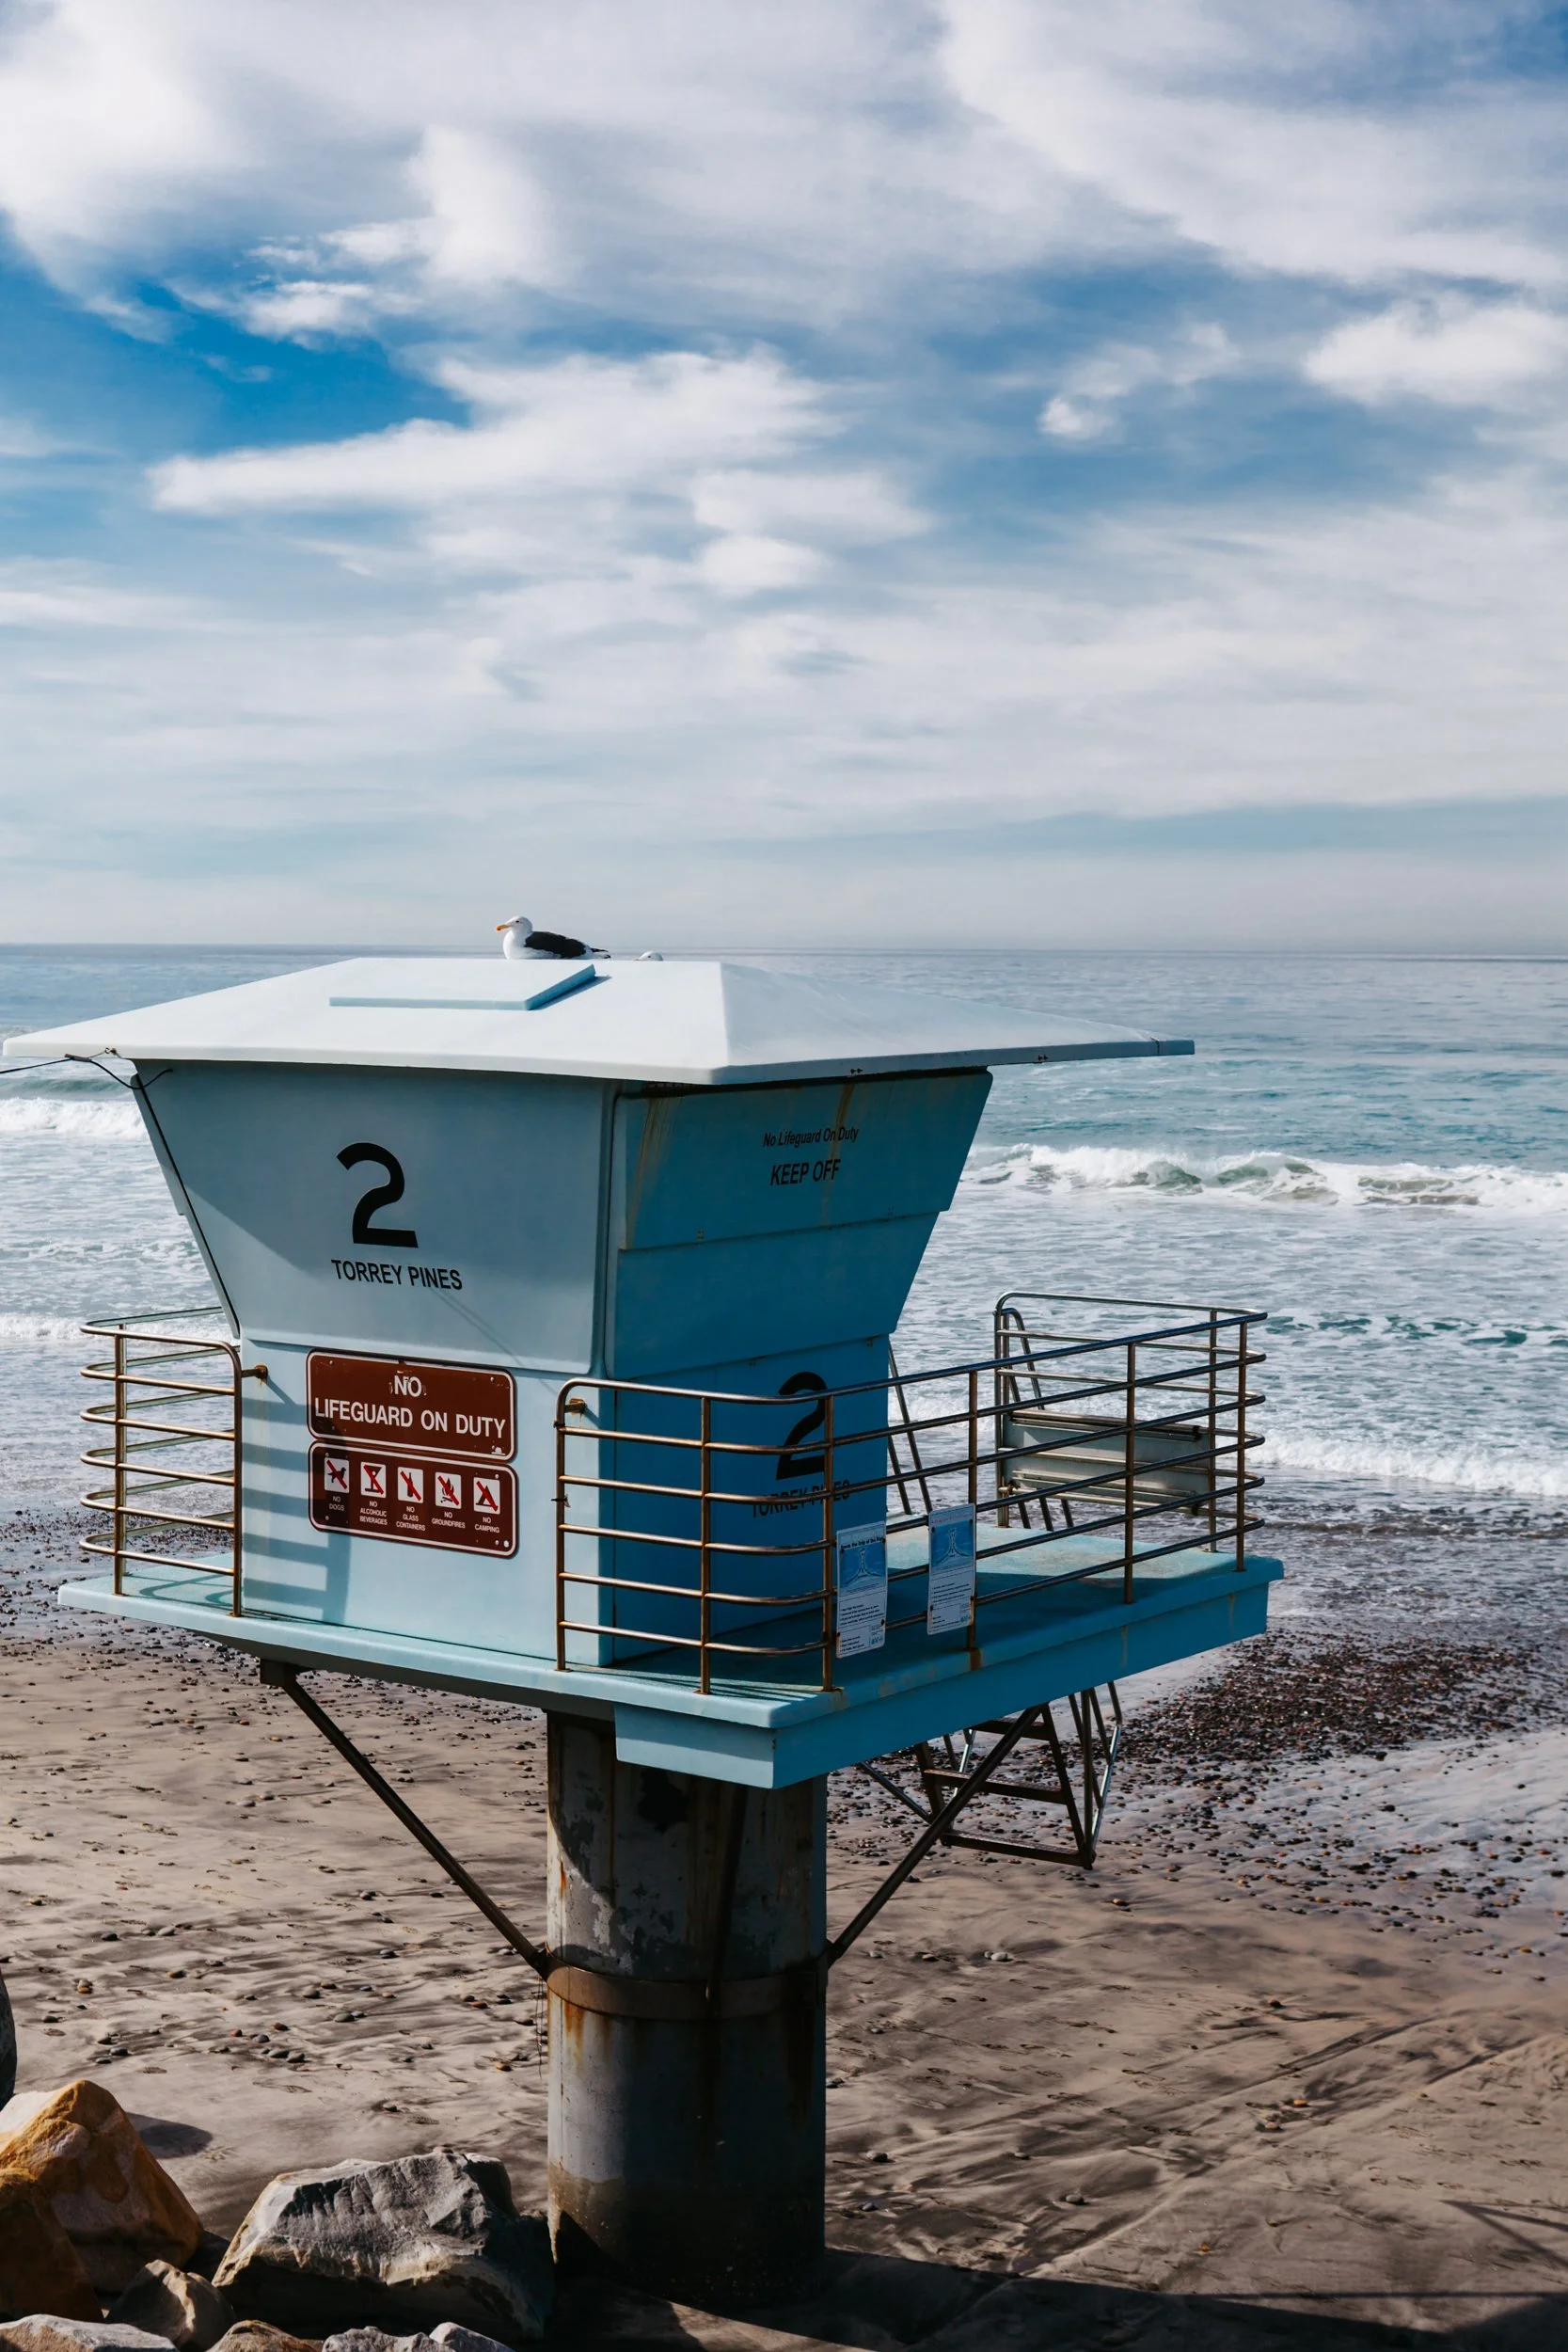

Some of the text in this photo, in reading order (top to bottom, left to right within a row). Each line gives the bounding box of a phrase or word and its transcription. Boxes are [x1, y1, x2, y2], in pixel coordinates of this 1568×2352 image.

[763, 1126, 859, 1148] No Lifeguard On Duty
[770, 1159, 841, 1185] KEEP OFF
[337, 1142, 419, 1248] 2
[331, 1259, 463, 1290] TORREY PINES
[393, 1375, 422, 1398] NO
[314, 1397, 506, 1438] LIFEGUARD ON DUTY
[776, 1371, 829, 1481] 2
[812, 1480, 850, 1506] PIES
[328, 1502, 345, 1512] DOGS
[359, 1507, 388, 1518] ALCOHOLIC
[402, 1513, 420, 1522] GLASS
[359, 1515, 388, 1526] BEVERAGES
[395, 1520, 426, 1532] CONTAINERS
[431, 1518, 467, 1529] GROUNDFIRES
[474, 1524, 500, 1534] CAMPING
